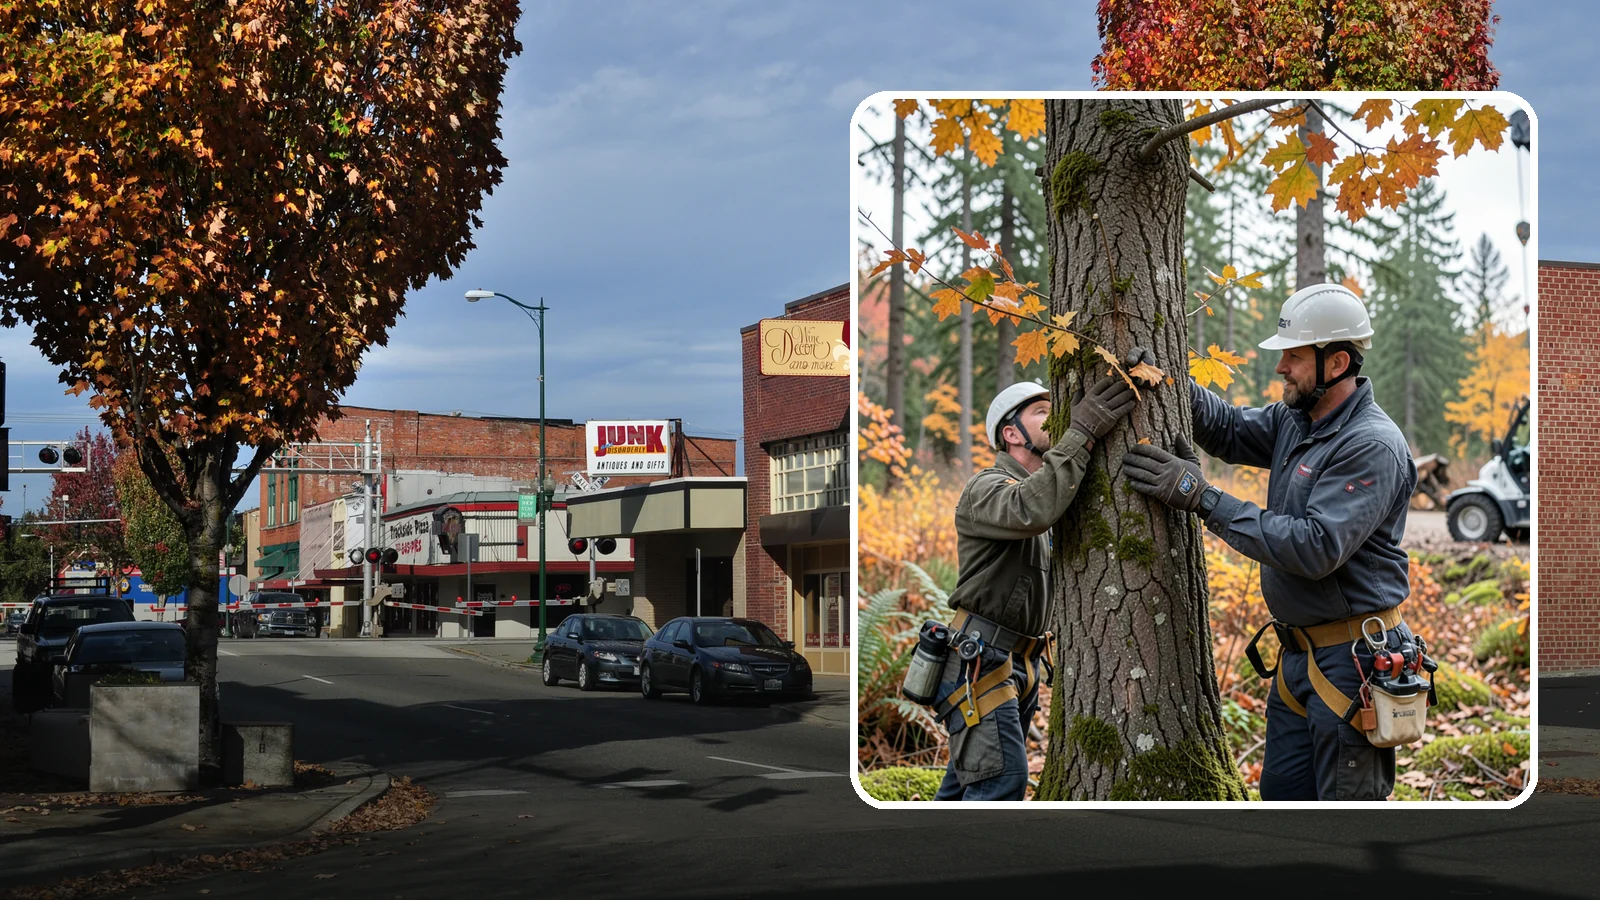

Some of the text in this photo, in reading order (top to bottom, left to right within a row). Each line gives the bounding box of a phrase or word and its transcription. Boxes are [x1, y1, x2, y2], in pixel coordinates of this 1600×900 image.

[791, 325, 823, 344] Wine
[765, 328, 831, 365] Decor
[595, 425, 665, 457] JUNK
[607, 446, 646, 455] DISORDERLY
[597, 460, 666, 470] ANTIQUES AND GIFTS
[390, 519, 429, 540] Trackside Pizza
